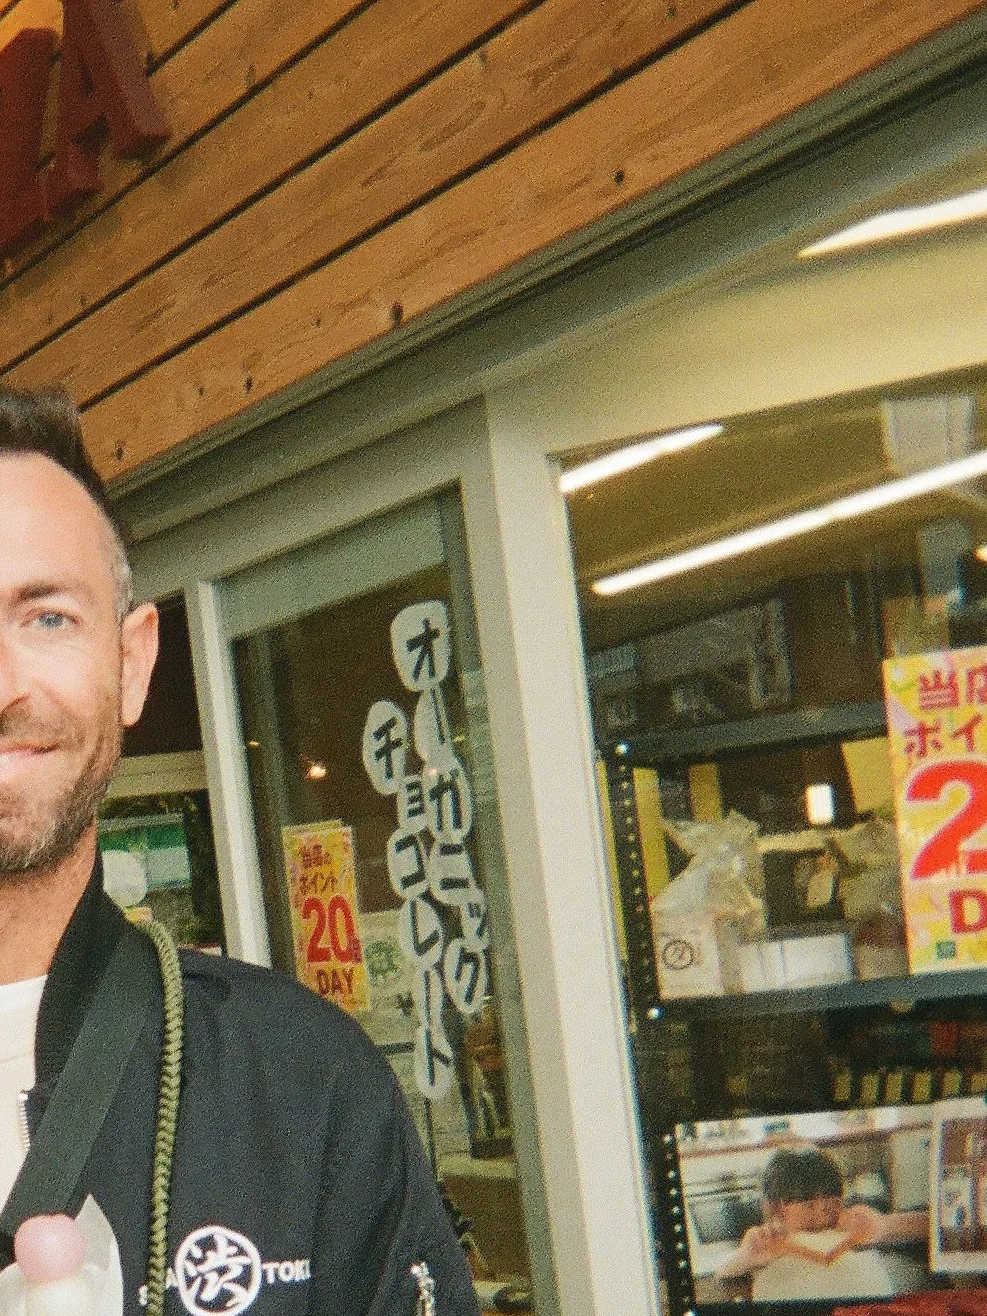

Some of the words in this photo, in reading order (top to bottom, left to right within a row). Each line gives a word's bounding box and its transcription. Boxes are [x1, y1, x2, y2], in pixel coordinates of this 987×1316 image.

[316, 967, 354, 995] DAY
[372, 716, 450, 1088] チョコレート
[405, 617, 485, 1006] オーガニック
